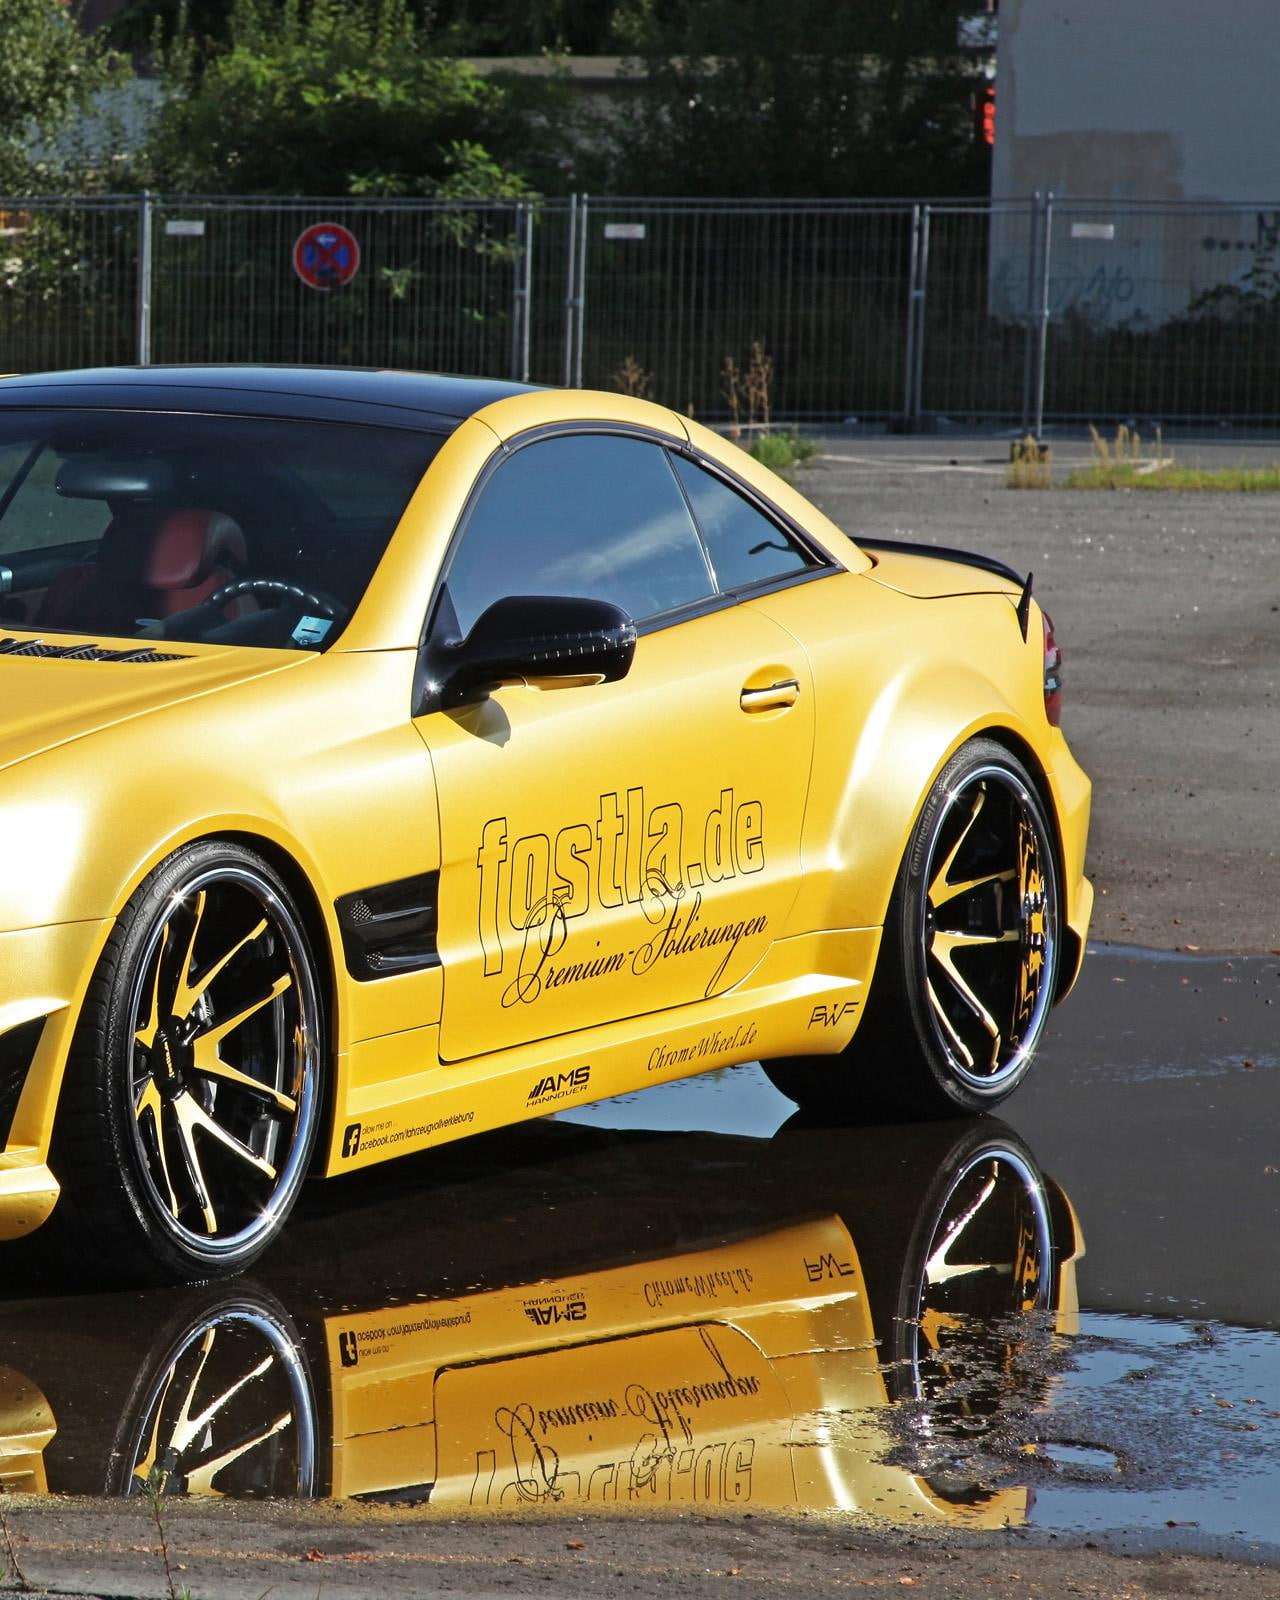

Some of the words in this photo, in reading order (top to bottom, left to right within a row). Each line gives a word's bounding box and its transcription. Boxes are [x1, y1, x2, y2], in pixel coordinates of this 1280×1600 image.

[477, 786, 766, 978] fostla.de
[647, 1022, 758, 1071] ChromeWheel.de
[528, 1065, 591, 1100] AMS
